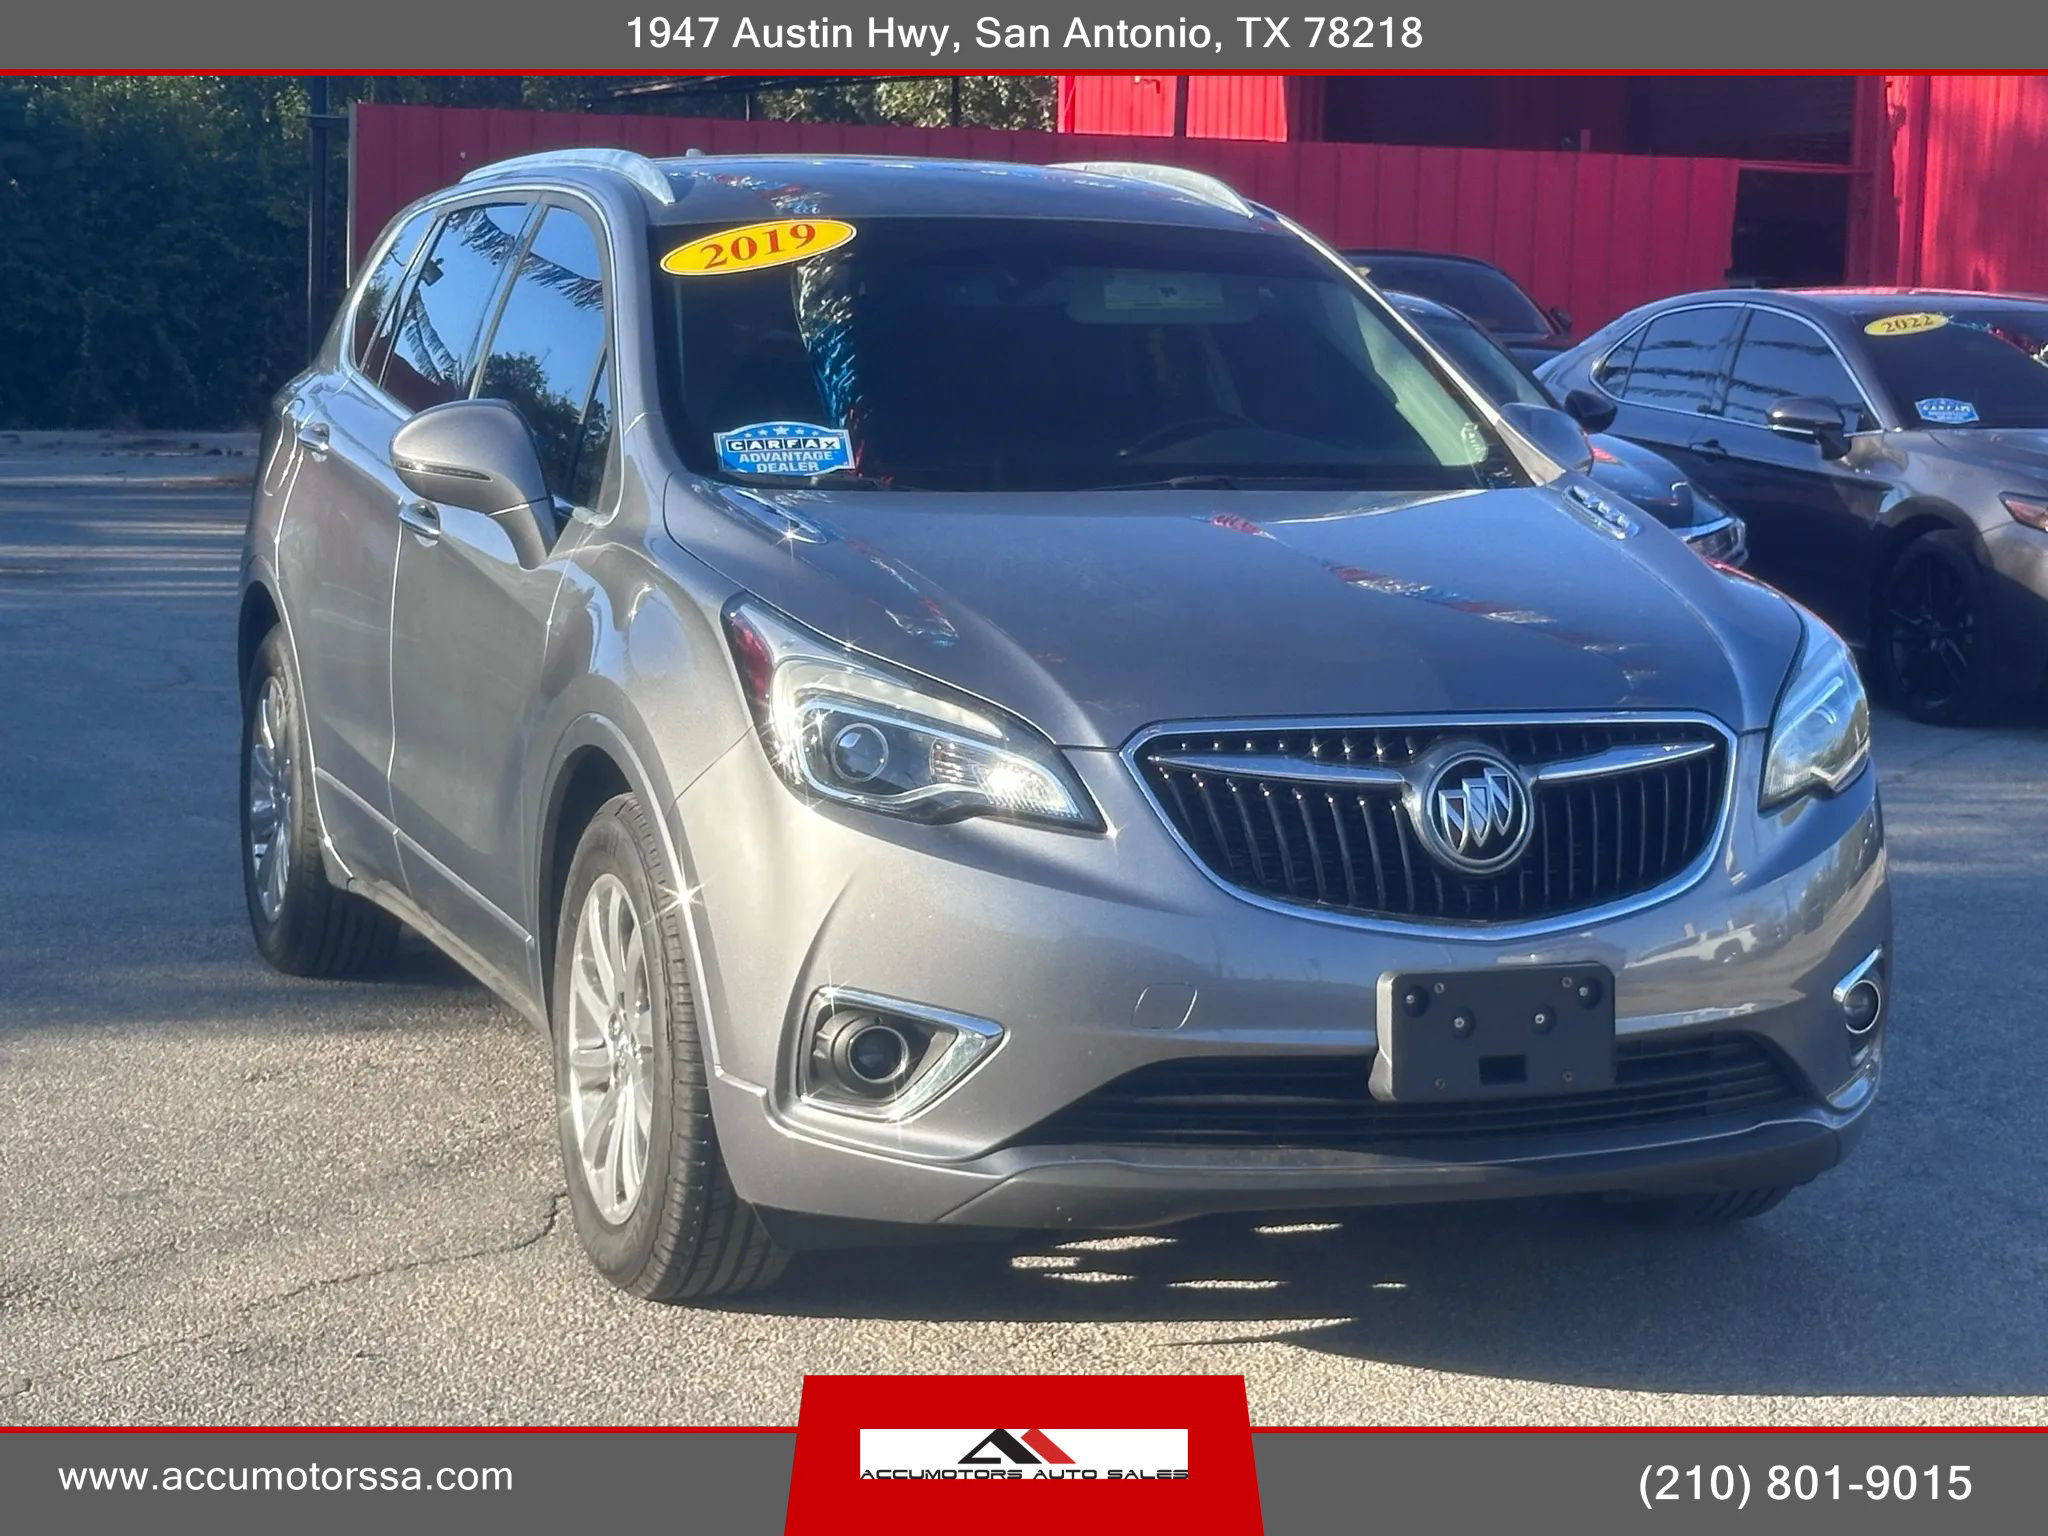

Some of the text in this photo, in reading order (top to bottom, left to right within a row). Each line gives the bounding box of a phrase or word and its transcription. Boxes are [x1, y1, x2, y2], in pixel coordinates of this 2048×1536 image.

[701, 223, 816, 269] 2019
[1882, 315, 1934, 333] 2022
[728, 438, 840, 451] CARFAX
[739, 451, 833, 463] ADVANTAGE
[757, 462, 819, 473] DEALER
